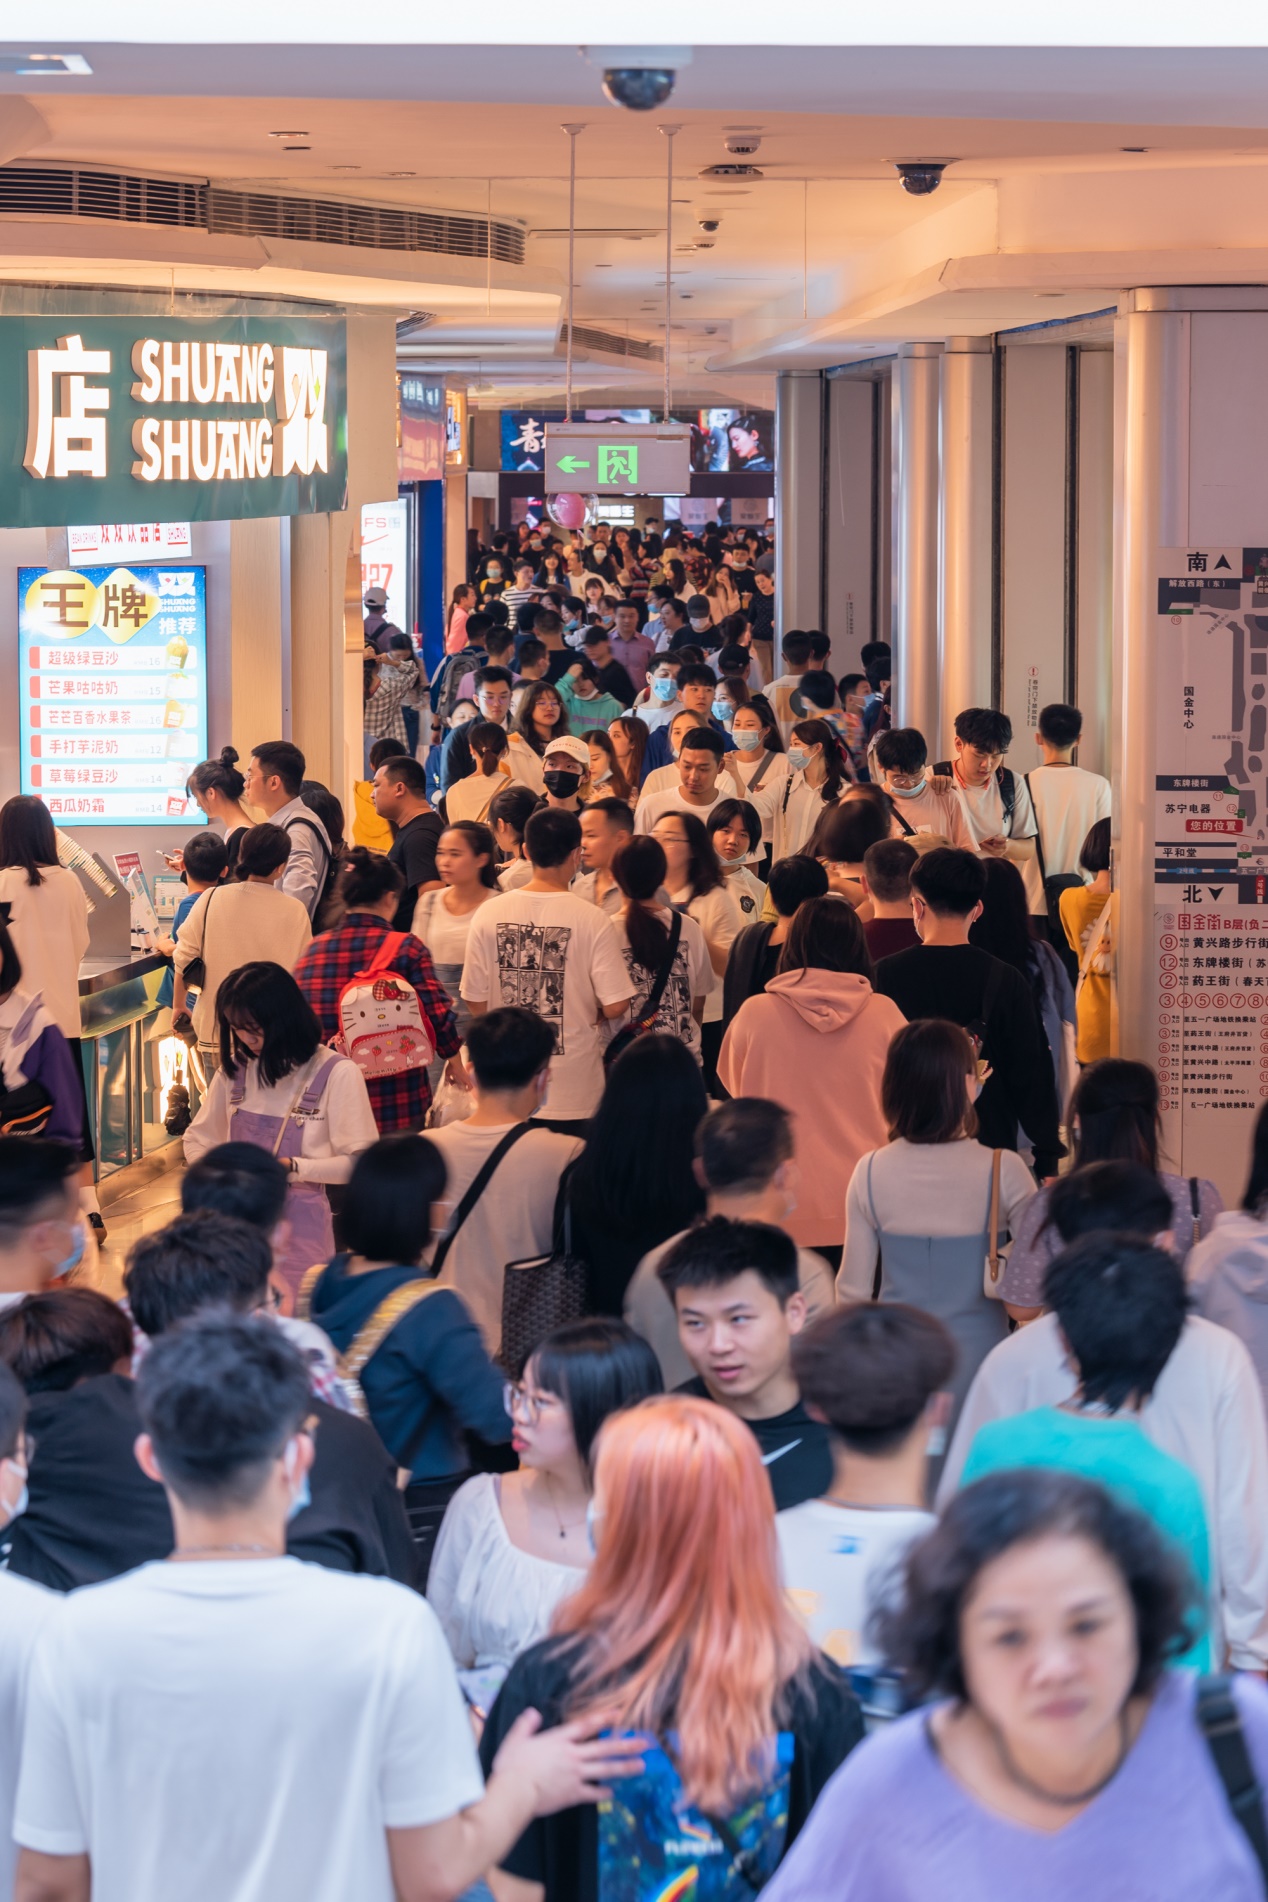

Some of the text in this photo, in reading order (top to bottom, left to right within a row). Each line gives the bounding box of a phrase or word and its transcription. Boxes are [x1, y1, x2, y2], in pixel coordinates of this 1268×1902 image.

[131, 339, 274, 403] SHUANG
[23, 334, 111, 479] 店
[131, 418, 273, 481] SHUANG
[1187, 552, 1208, 572] 南
[40, 582, 149, 628] 王牌
[159, 617, 197, 635] 推荐
[48, 650, 119, 666] 超级绿豆沙
[48, 680, 119, 695] 芒果咕咕奶
[1184, 686, 1194, 729] 国金中心
[49, 710, 131, 725] 芒芒百香水果茶
[49, 740, 119, 755] 手打芋泥奶
[49, 769, 119, 784] 草莓绿豆沙
[1174, 779, 1209, 788] 东牌楼街
[49, 798, 105, 814] 西瓜奶霜
[1165, 804, 1211, 814] 苏宁电器
[1190, 821, 1237, 831] 您的位置
[1163, 847, 1197, 858] 平和堂
[1182, 885, 1202, 903] 北
[1193, 937, 1268, 949] 黄兴路步行街
